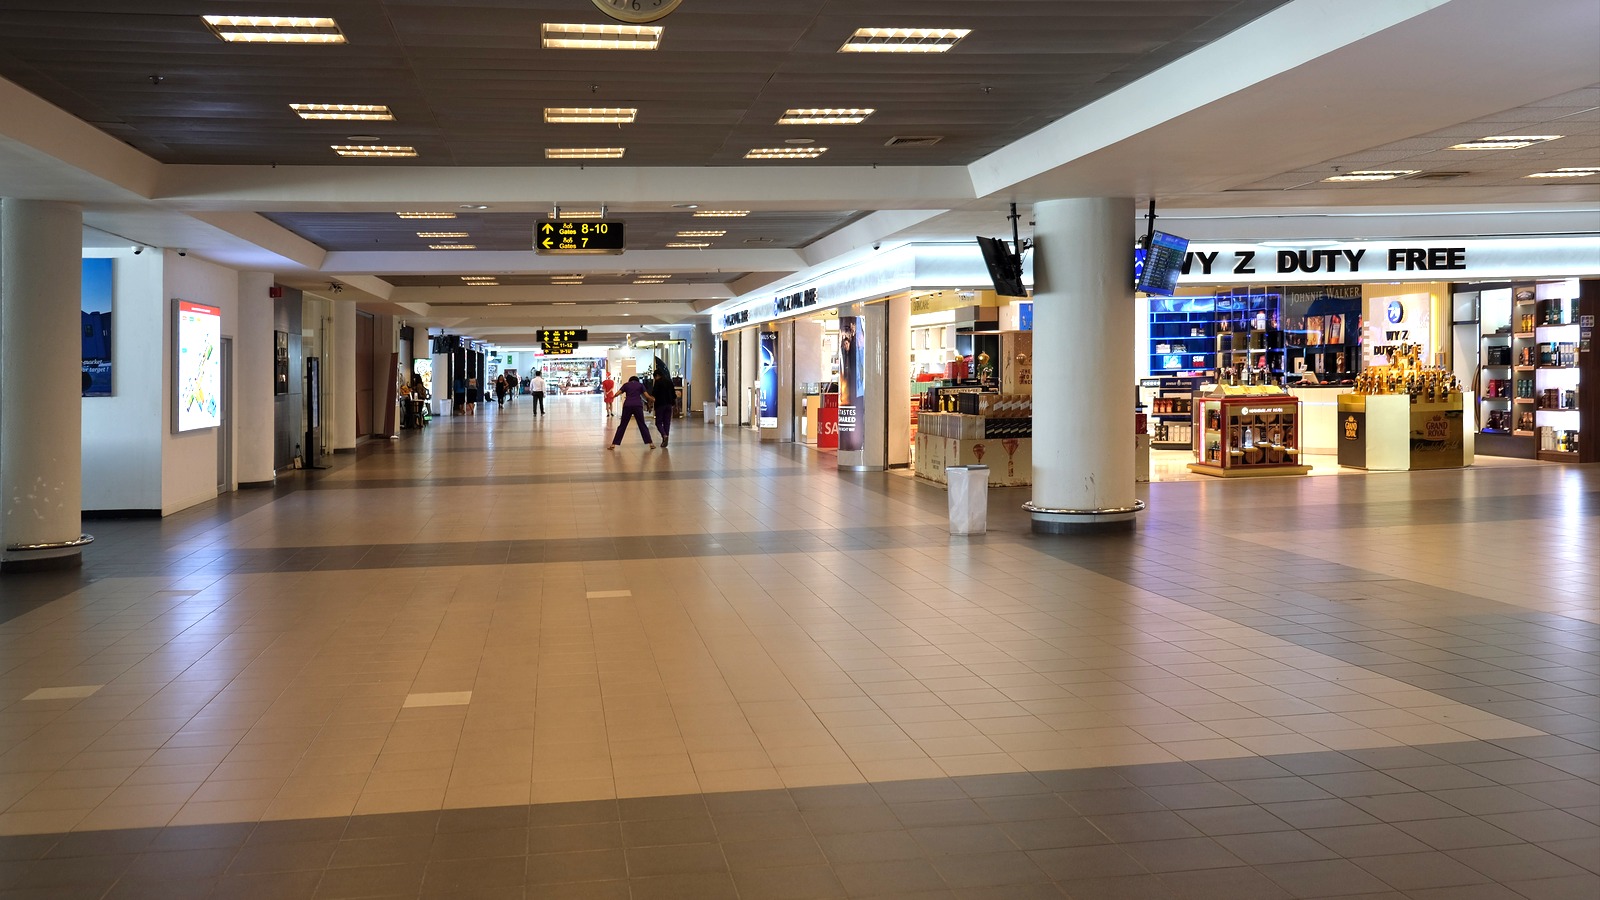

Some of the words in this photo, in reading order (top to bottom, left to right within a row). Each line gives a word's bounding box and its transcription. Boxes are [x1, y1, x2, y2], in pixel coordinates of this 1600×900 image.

[581, 223, 608, 234] 8-10
[581, 237, 589, 248] 7
[1234, 251, 1256, 274] Z
[1277, 249, 1366, 273] DUTY
[1388, 248, 1466, 271] FREE
[1290, 291, 1323, 306] JOHNNIE
[1326, 287, 1360, 299] WALKER
[1345, 422, 1358, 430] GRAND
[1426, 422, 1448, 430] GRAND
